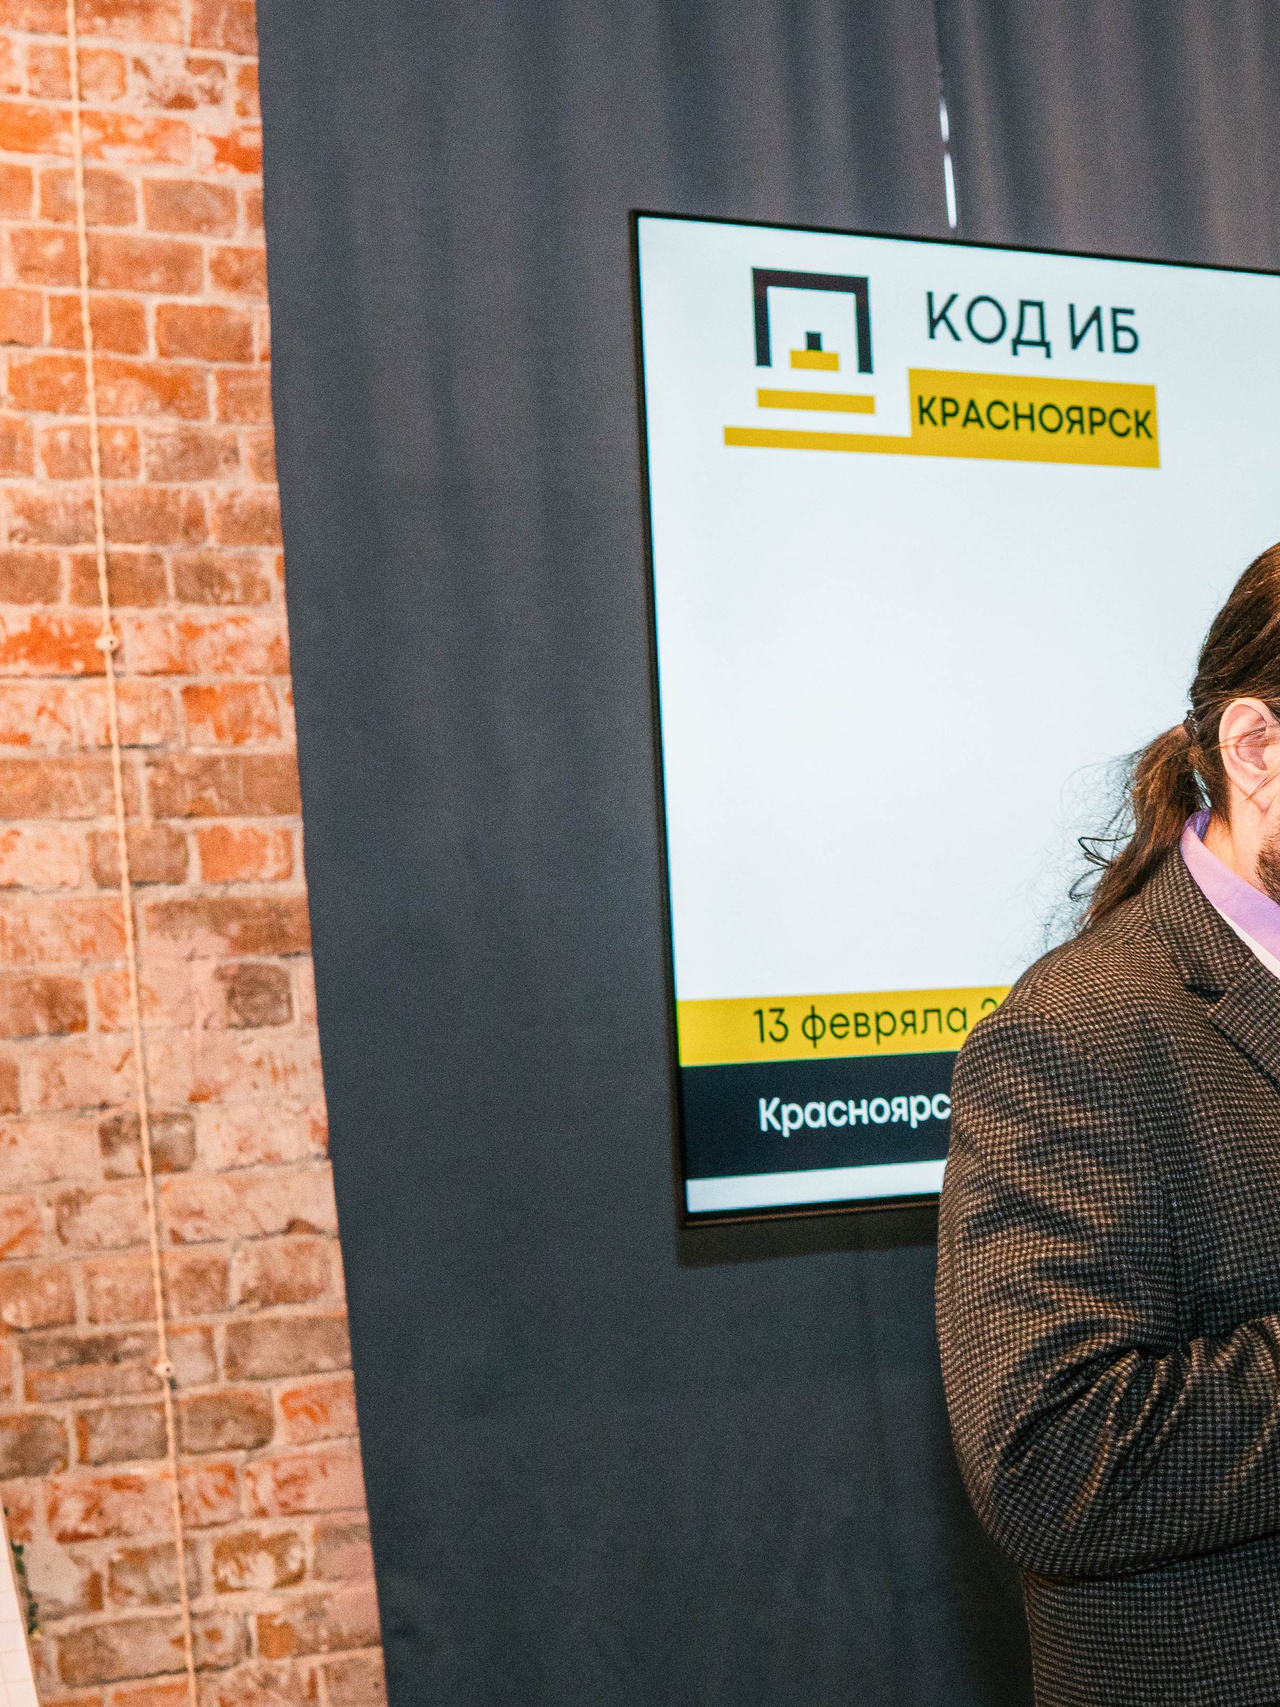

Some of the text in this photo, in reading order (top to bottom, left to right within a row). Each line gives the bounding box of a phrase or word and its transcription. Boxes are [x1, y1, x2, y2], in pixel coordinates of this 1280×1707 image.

[926, 290, 1140, 359] КОД ИБ
[916, 394, 1154, 440] КРАСНОЯРСК
[753, 1004, 968, 1049] 13 февряла
[758, 1093, 952, 1138] Красноярс
